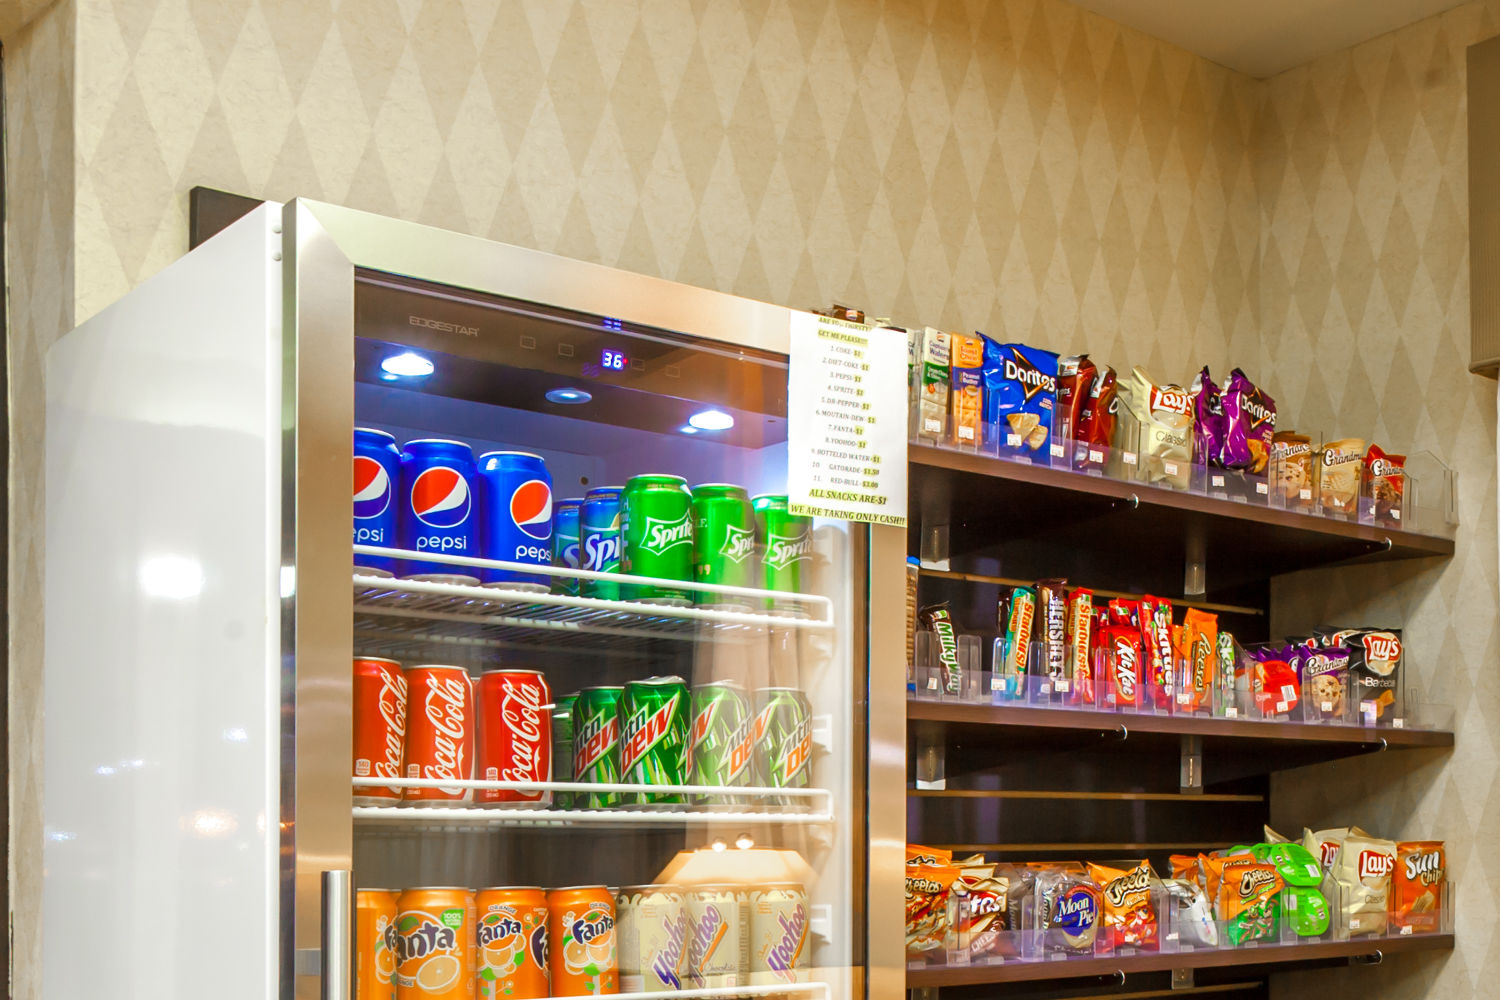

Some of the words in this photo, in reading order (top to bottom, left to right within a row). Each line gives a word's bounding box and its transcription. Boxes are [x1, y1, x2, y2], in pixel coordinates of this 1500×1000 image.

[409, 316, 478, 337] EDGESTAR
[818, 329, 830, 337] GET
[604, 352, 622, 369] 36
[1004, 359, 1056, 393] Doritos
[1241, 394, 1277, 426] Doritos
[809, 488, 825, 498] ALL
[826, 490, 857, 502] SNACKS
[790, 504, 804, 513] WE
[806, 506, 822, 516] ARE
[823, 508, 855, 520] TAKING
[855, 511, 879, 522] ONLY
[416, 536, 467, 552] pepsi
[516, 545, 551, 562] peps
[1369, 636, 1400, 661] Lay's
[1361, 851, 1394, 877] Lay's
[1405, 851, 1439, 880] Sun
[488, 904, 517, 914] ORANGE
[1059, 897, 1089, 917] Moon
[1078, 909, 1093, 927] Pie
